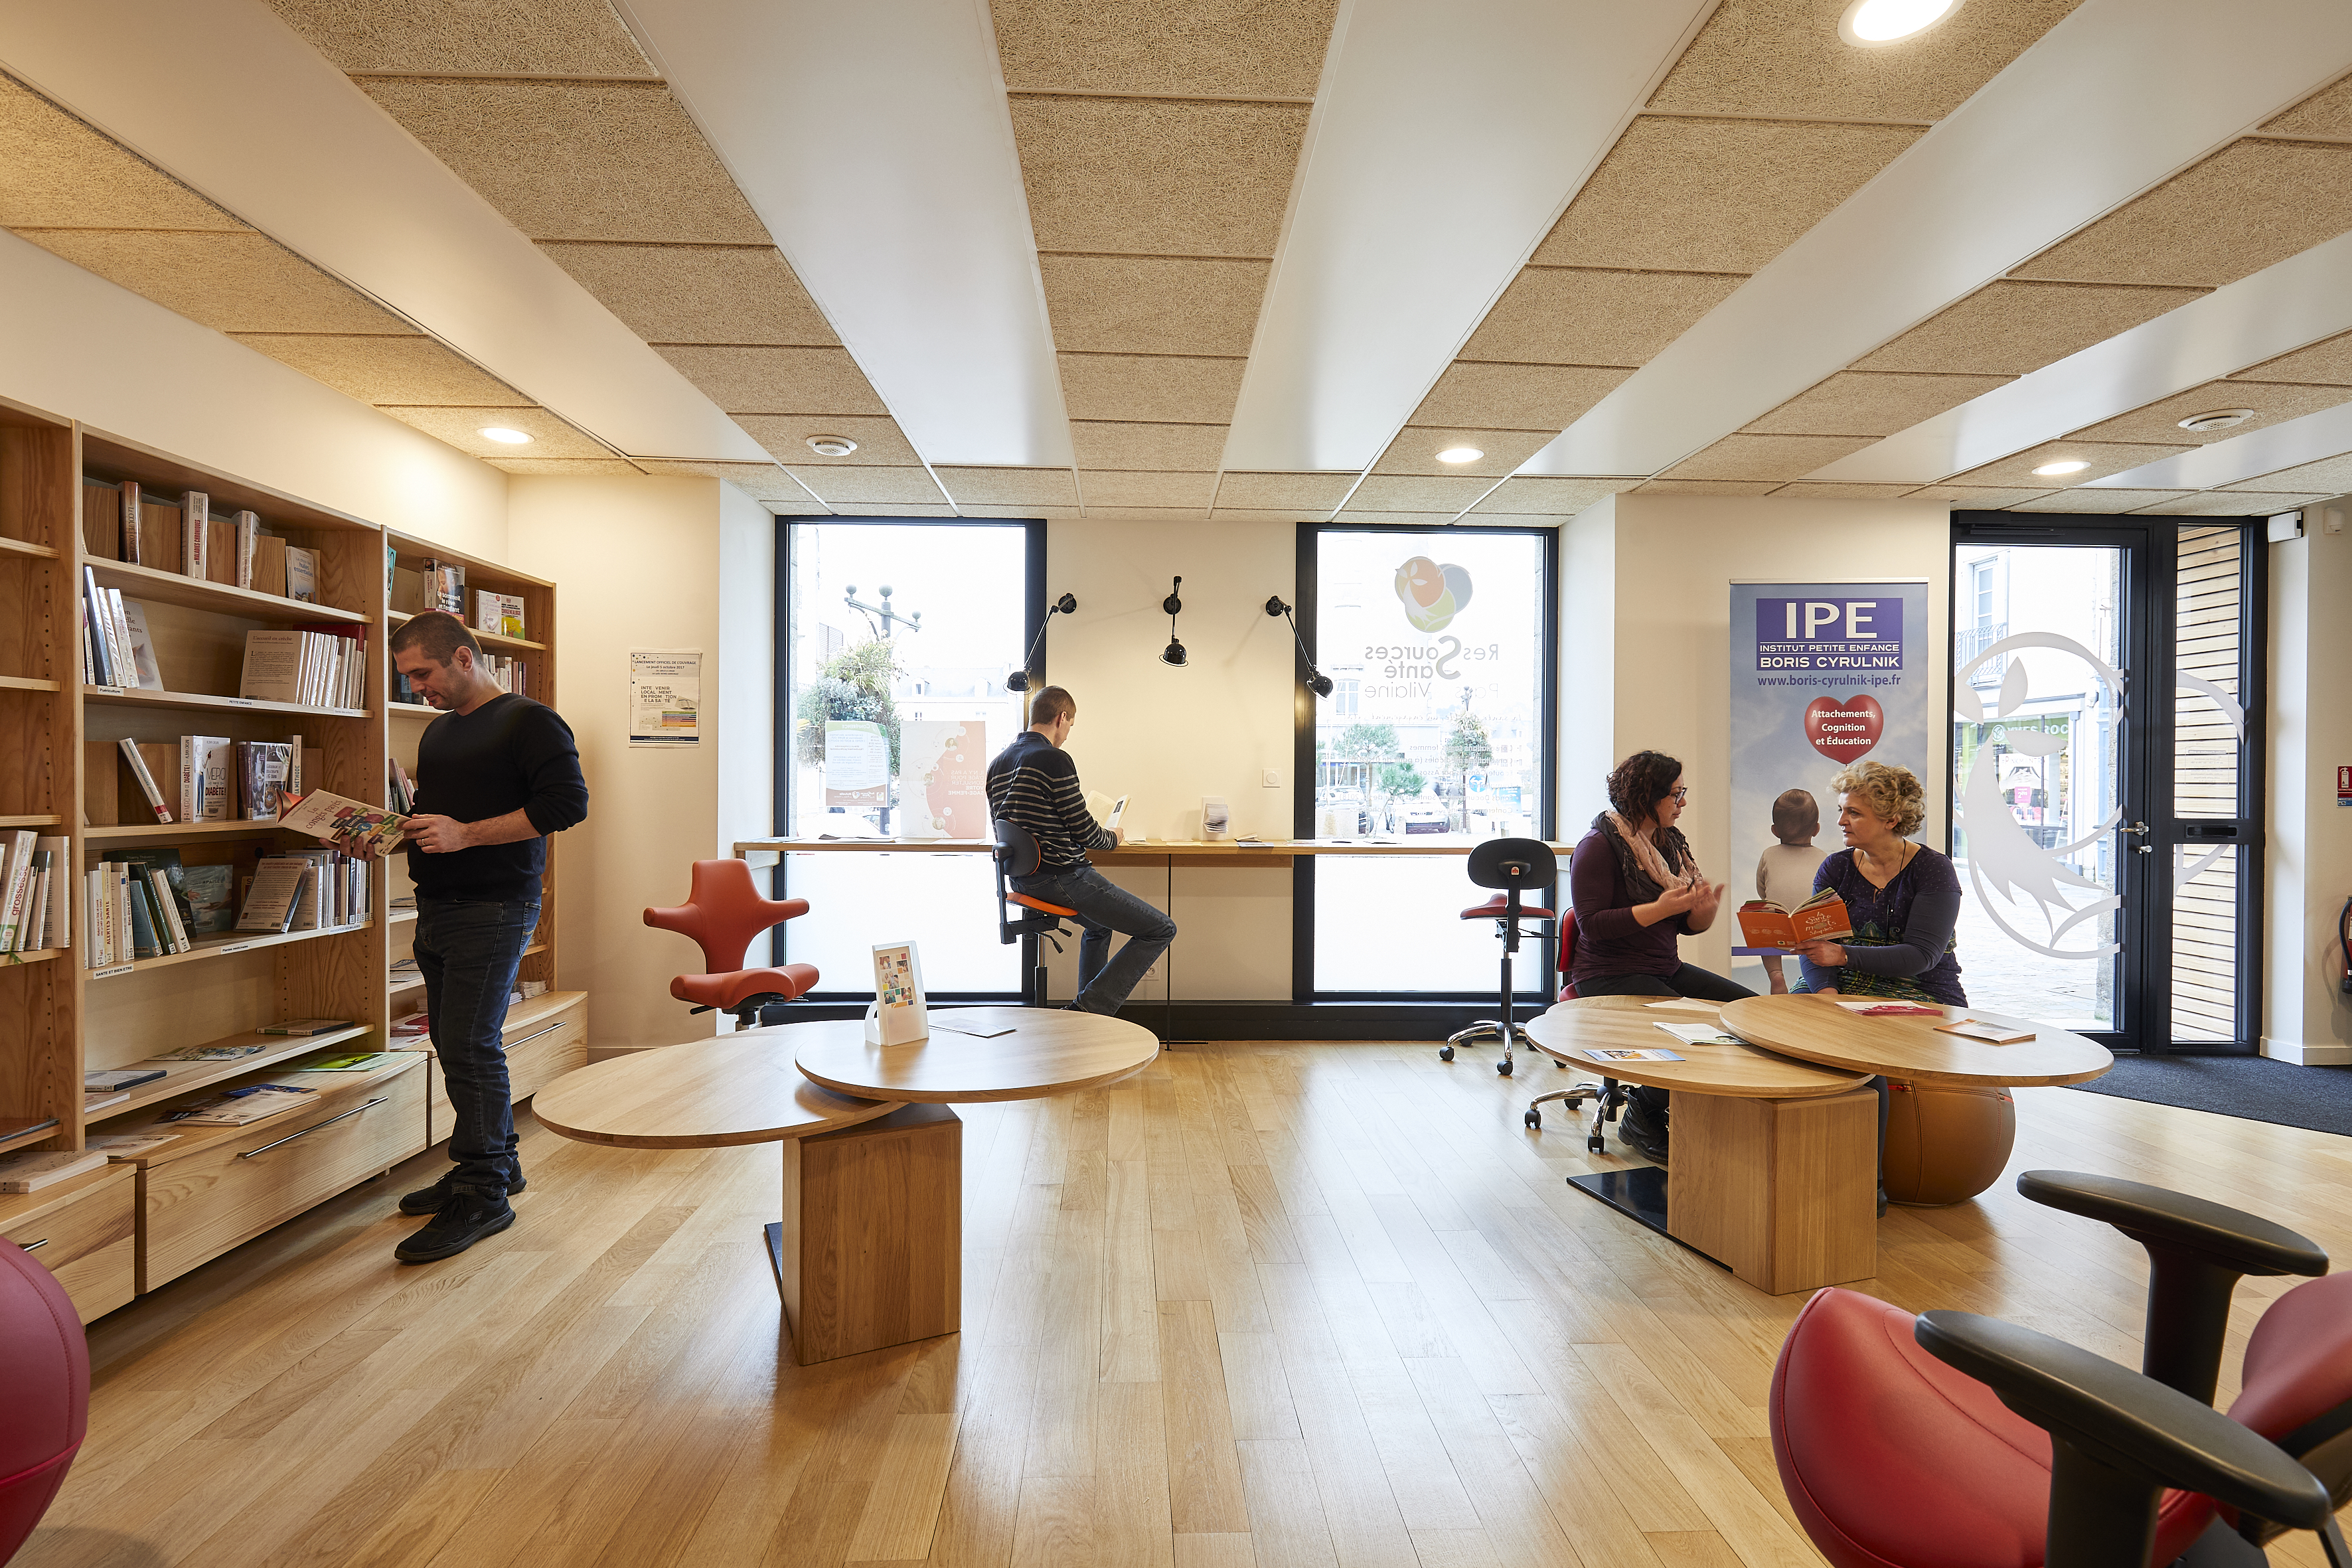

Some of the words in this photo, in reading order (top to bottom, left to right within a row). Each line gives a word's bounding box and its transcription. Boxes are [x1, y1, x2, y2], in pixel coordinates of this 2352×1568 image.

[1786, 601, 1877, 639] IPE
[1760, 657, 1810, 668] BORIS
[1816, 657, 1900, 668] CYRULNIK
[1758, 674, 1901, 688] www.boris-cyrulnik-ipe.fr
[1812, 709, 1876, 719] Attachements,
[1822, 723, 1865, 734] Cognition
[1826, 736, 1871, 745] Éducation
[306, 812, 327, 829] congés
[325, 799, 342, 813] payés
[12, 866, 28, 916] grossesse
[1806, 915, 1832, 923] Santé
